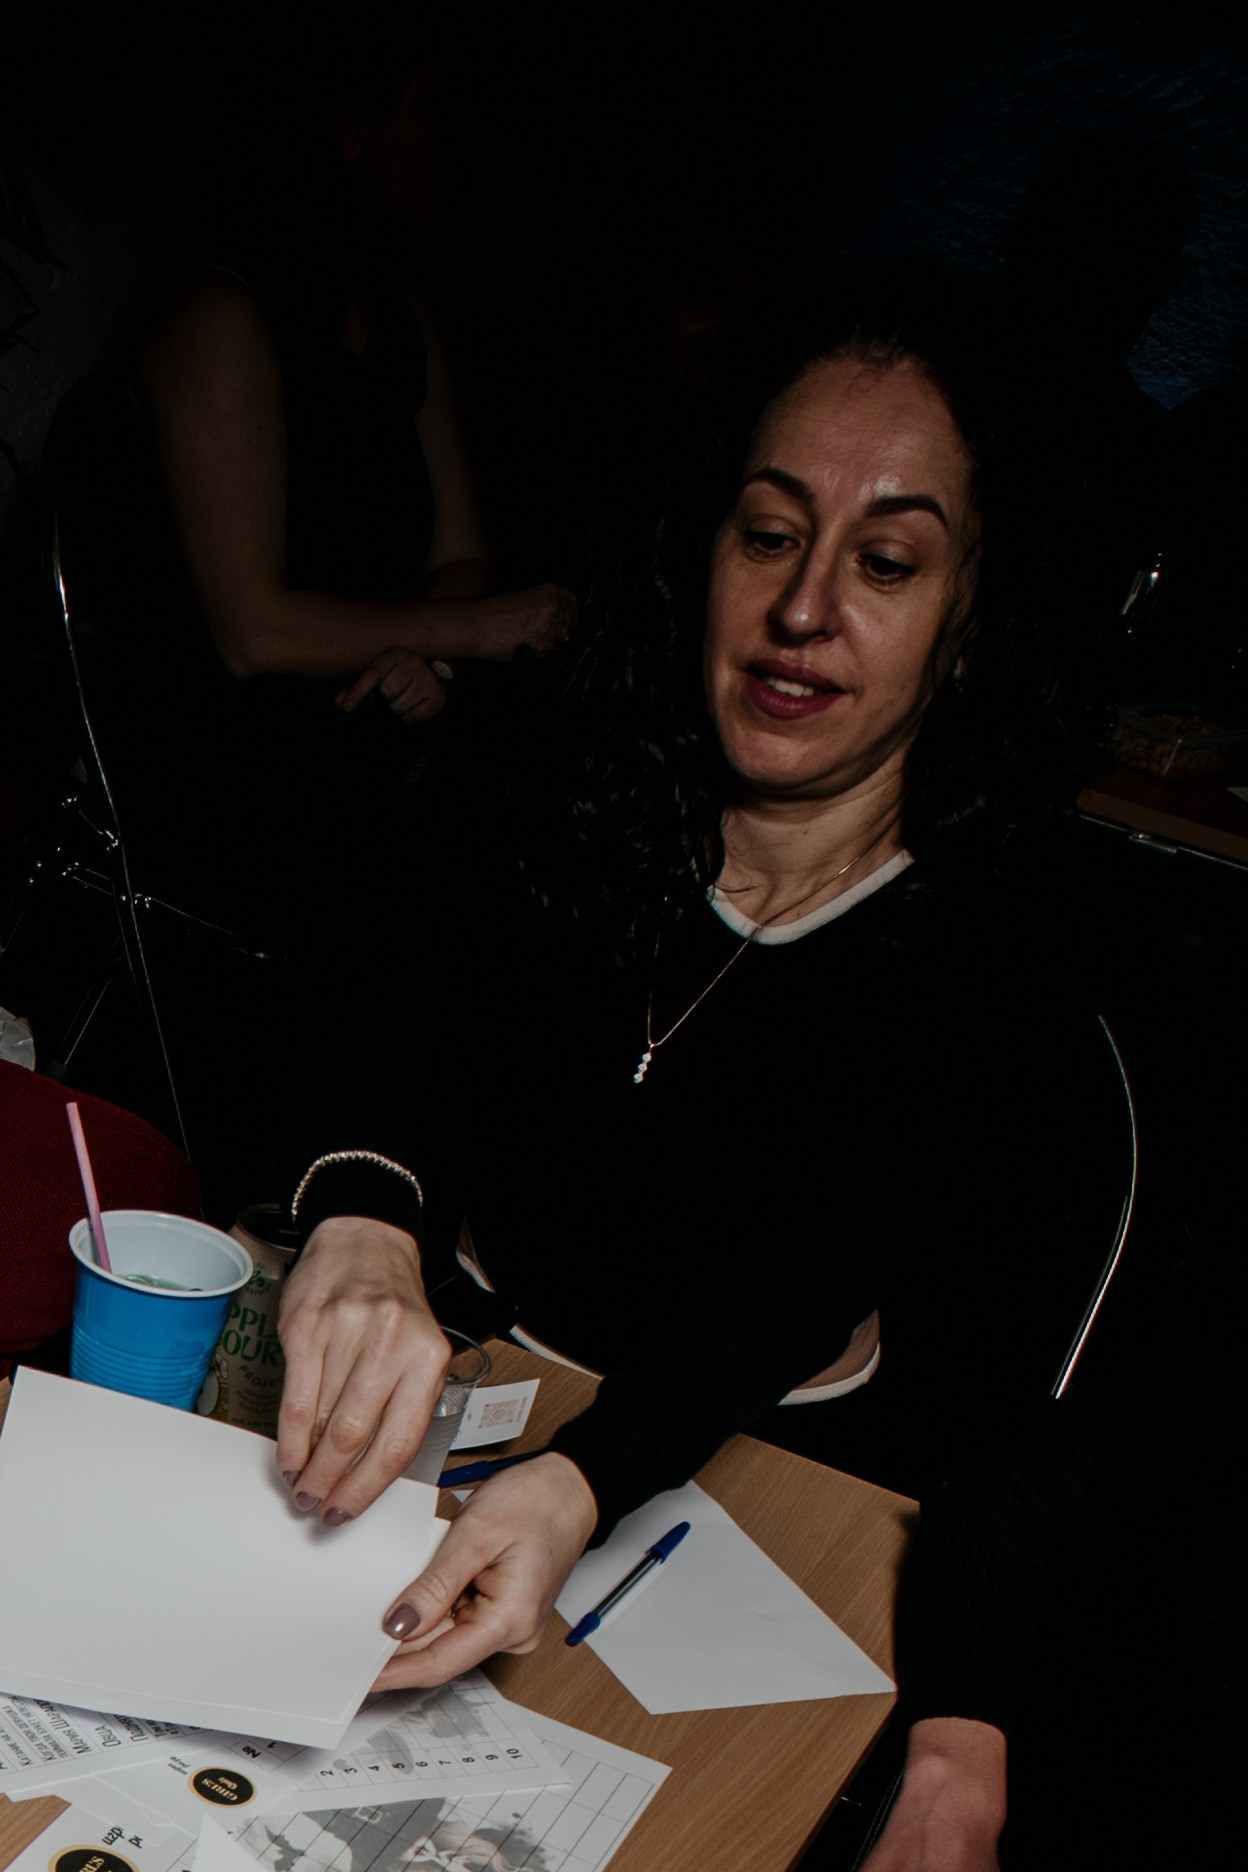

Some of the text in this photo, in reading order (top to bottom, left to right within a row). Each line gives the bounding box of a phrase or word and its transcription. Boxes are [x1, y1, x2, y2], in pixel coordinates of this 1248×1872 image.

[241, 1745, 262, 1759] №
[506, 1748, 523, 1760] 10
[392, 1762, 405, 1770] 5
[415, 1760, 429, 1768] 6
[320, 1769, 335, 1777] 2
[344, 1767, 357, 1775] 3
[202, 1778, 239, 1801] GIRL'S
[102, 1826, 125, 1846] игр
